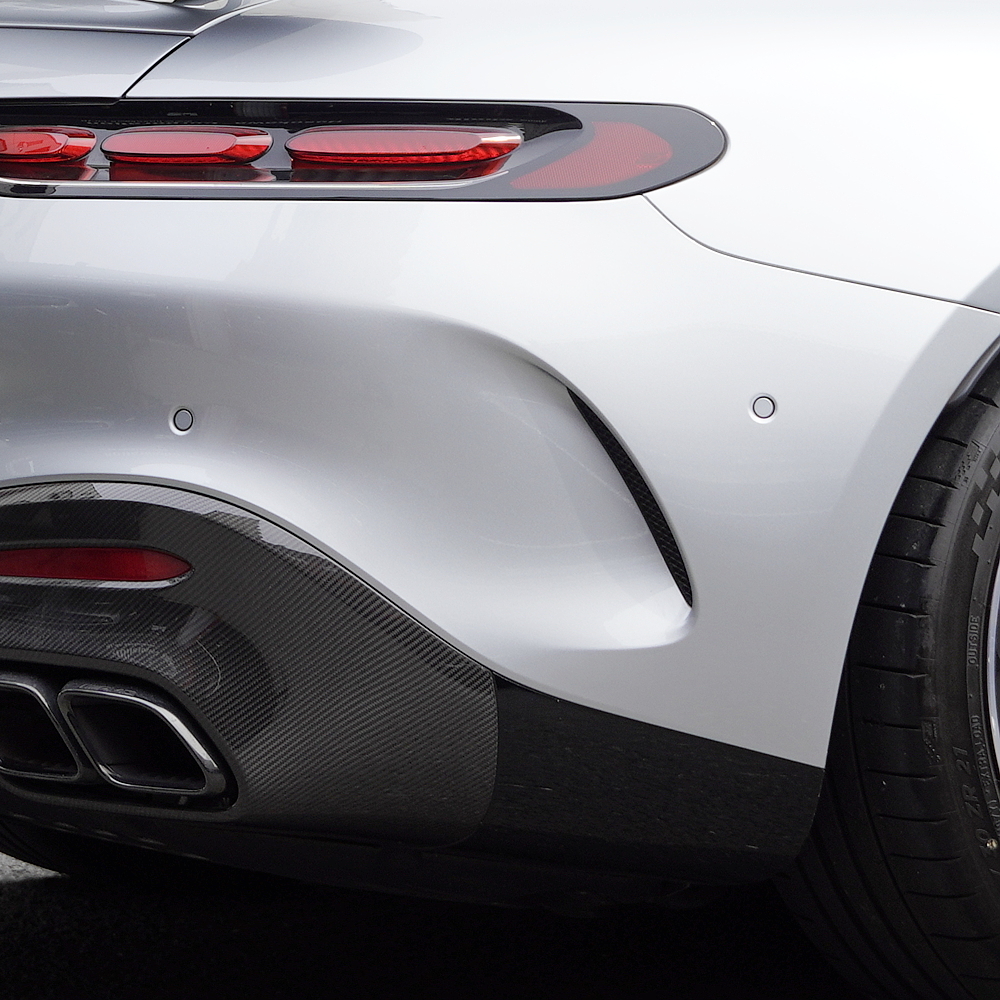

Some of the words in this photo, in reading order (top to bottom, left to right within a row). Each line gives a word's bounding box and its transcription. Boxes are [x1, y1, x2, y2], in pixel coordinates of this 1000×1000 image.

[967, 615, 981, 665] OUTSIDE
[971, 714, 985, 747] LOAD
[952, 746, 971, 775] 21
[961, 784, 983, 818] ZR
